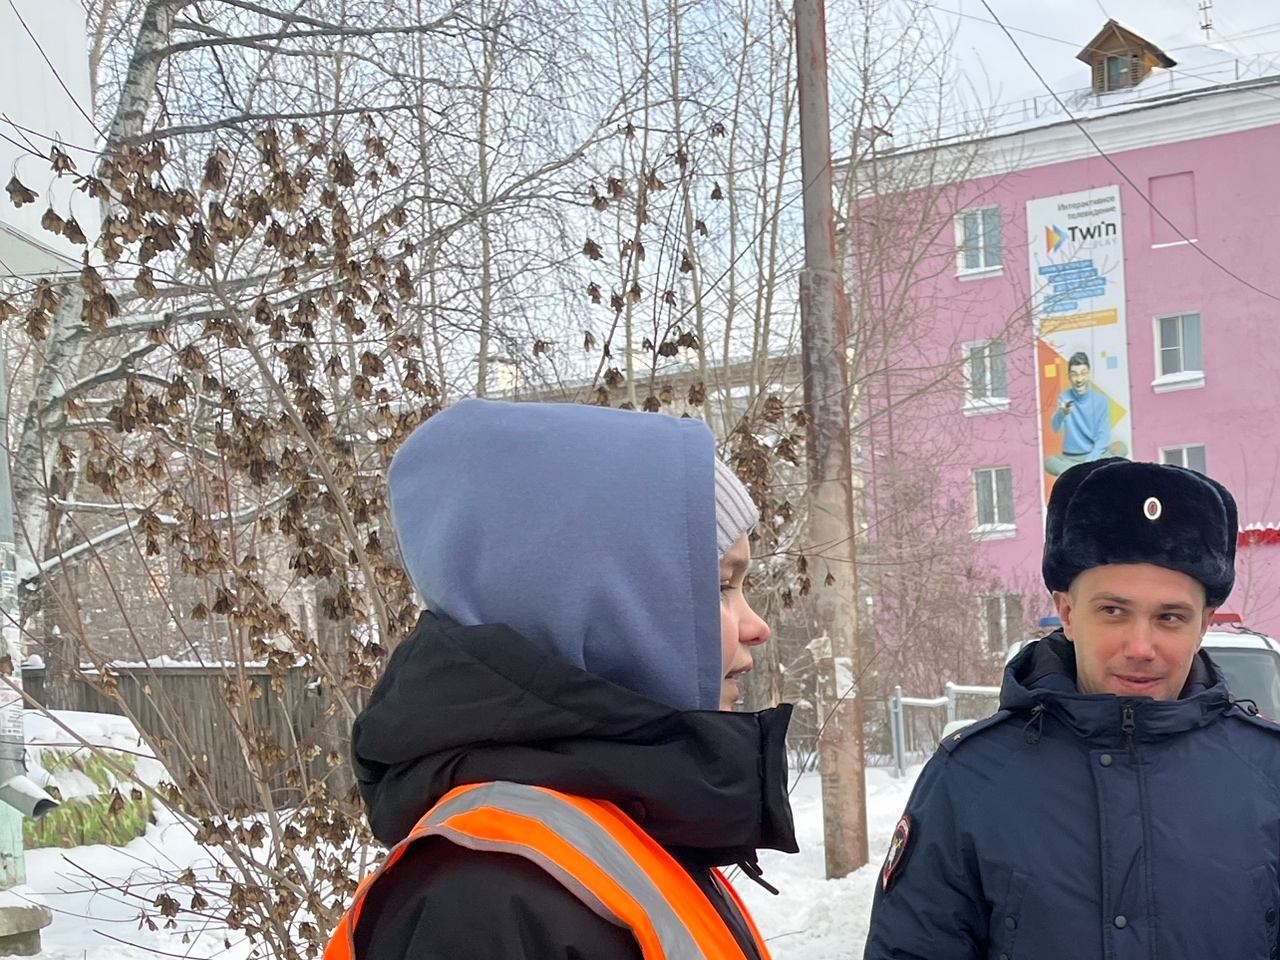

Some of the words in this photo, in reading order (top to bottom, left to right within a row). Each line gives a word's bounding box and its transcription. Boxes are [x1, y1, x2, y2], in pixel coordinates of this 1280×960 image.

[1057, 195, 1115, 211] Интерактивное
[1067, 206, 1116, 220] телевидение
[1068, 221, 1116, 241] Twin
